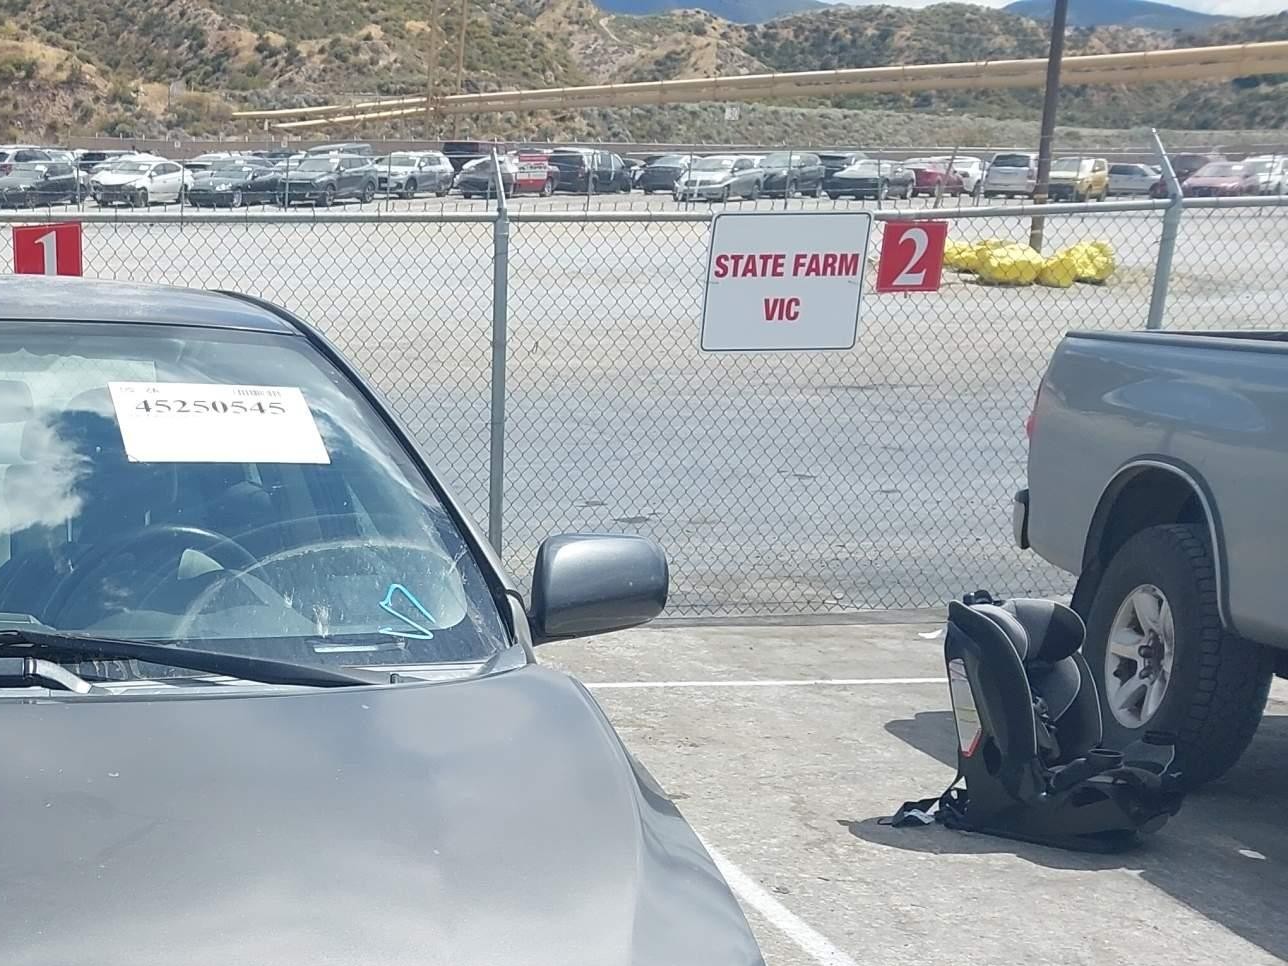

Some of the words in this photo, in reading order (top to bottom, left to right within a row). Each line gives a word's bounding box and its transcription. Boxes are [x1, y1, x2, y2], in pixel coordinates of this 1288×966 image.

[33, 230, 57, 276] 1
[714, 253, 786, 278] STATE
[792, 252, 860, 277] FARM
[892, 227, 928, 286] 2
[764, 297, 800, 321] VIC
[135, 399, 286, 415] 45250545
